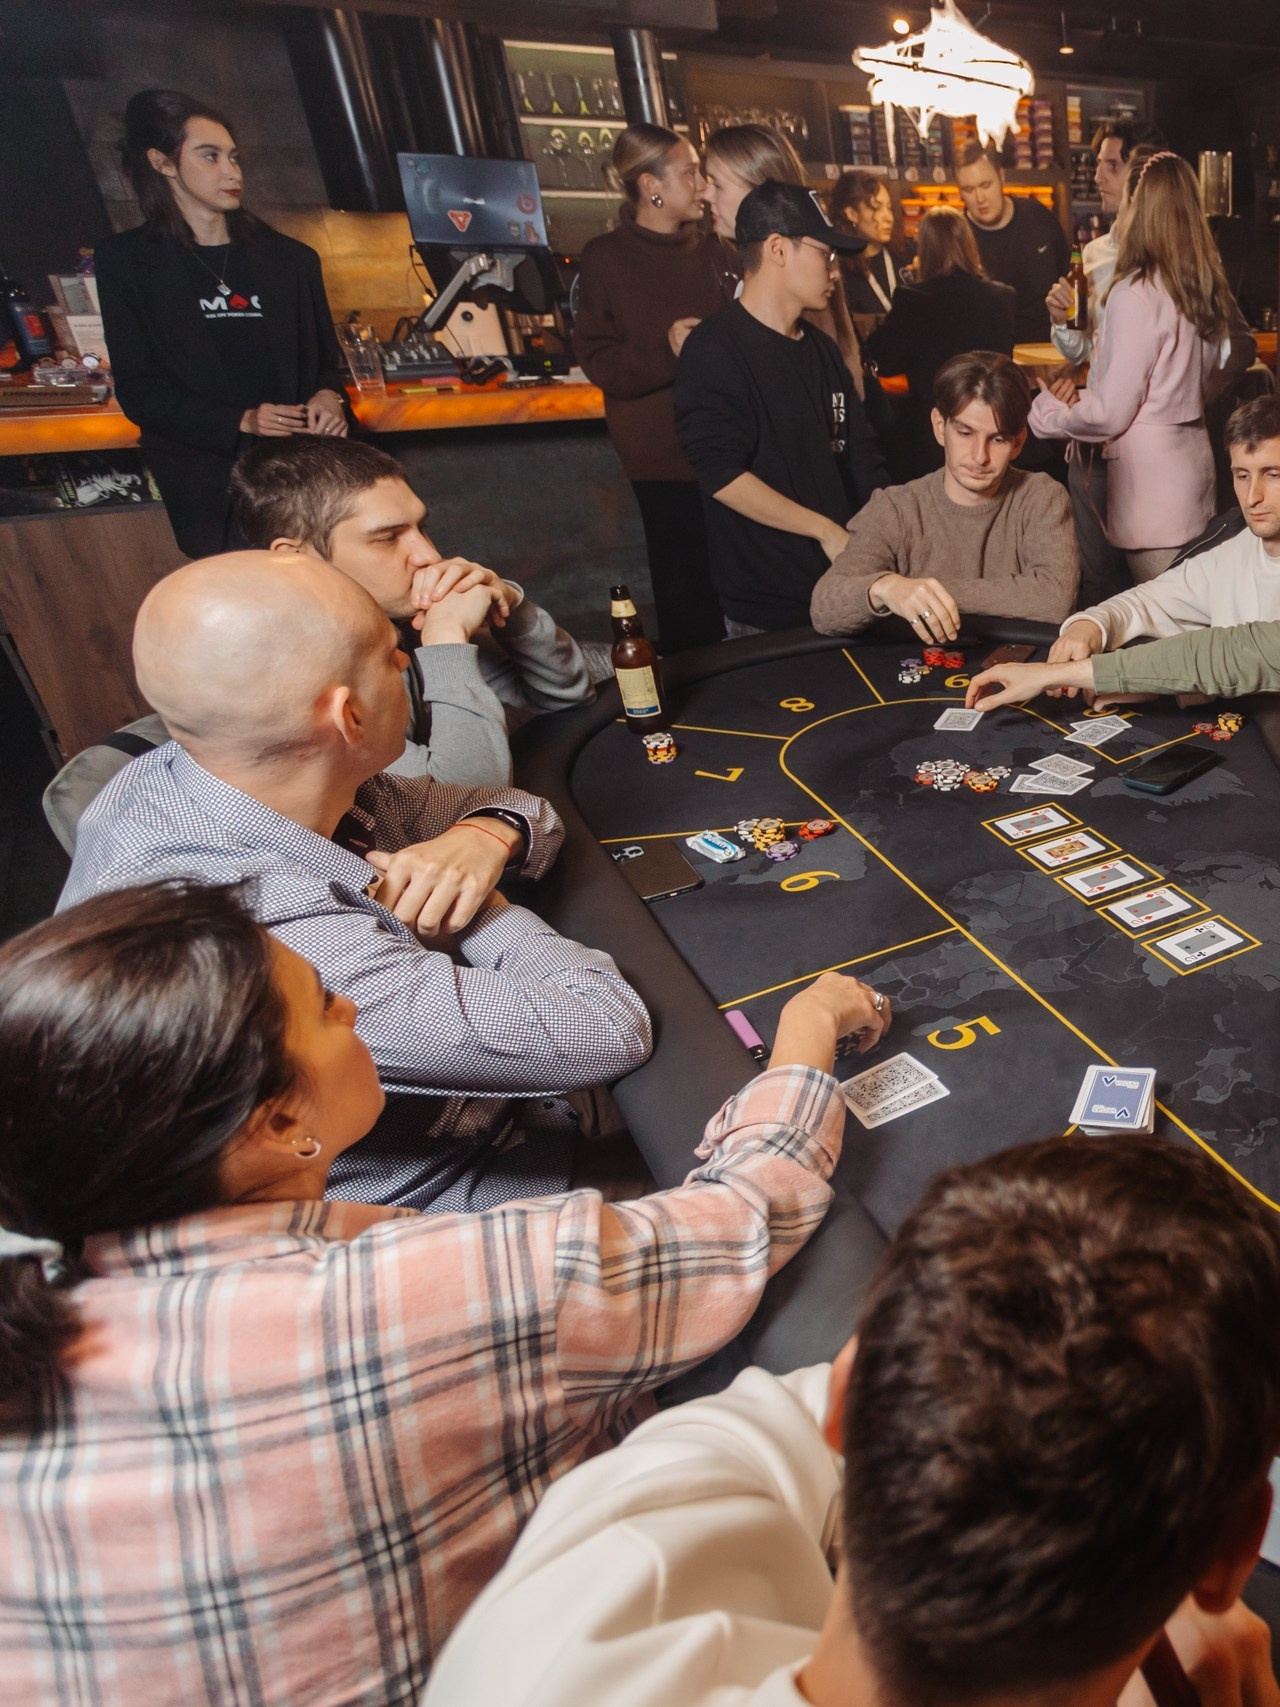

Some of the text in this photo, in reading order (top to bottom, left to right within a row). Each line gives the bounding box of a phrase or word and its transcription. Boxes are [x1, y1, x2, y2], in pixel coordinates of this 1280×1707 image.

[779, 697, 815, 712] 8
[694, 767, 744, 782] 7
[926, 1015, 1001, 1050] 5
